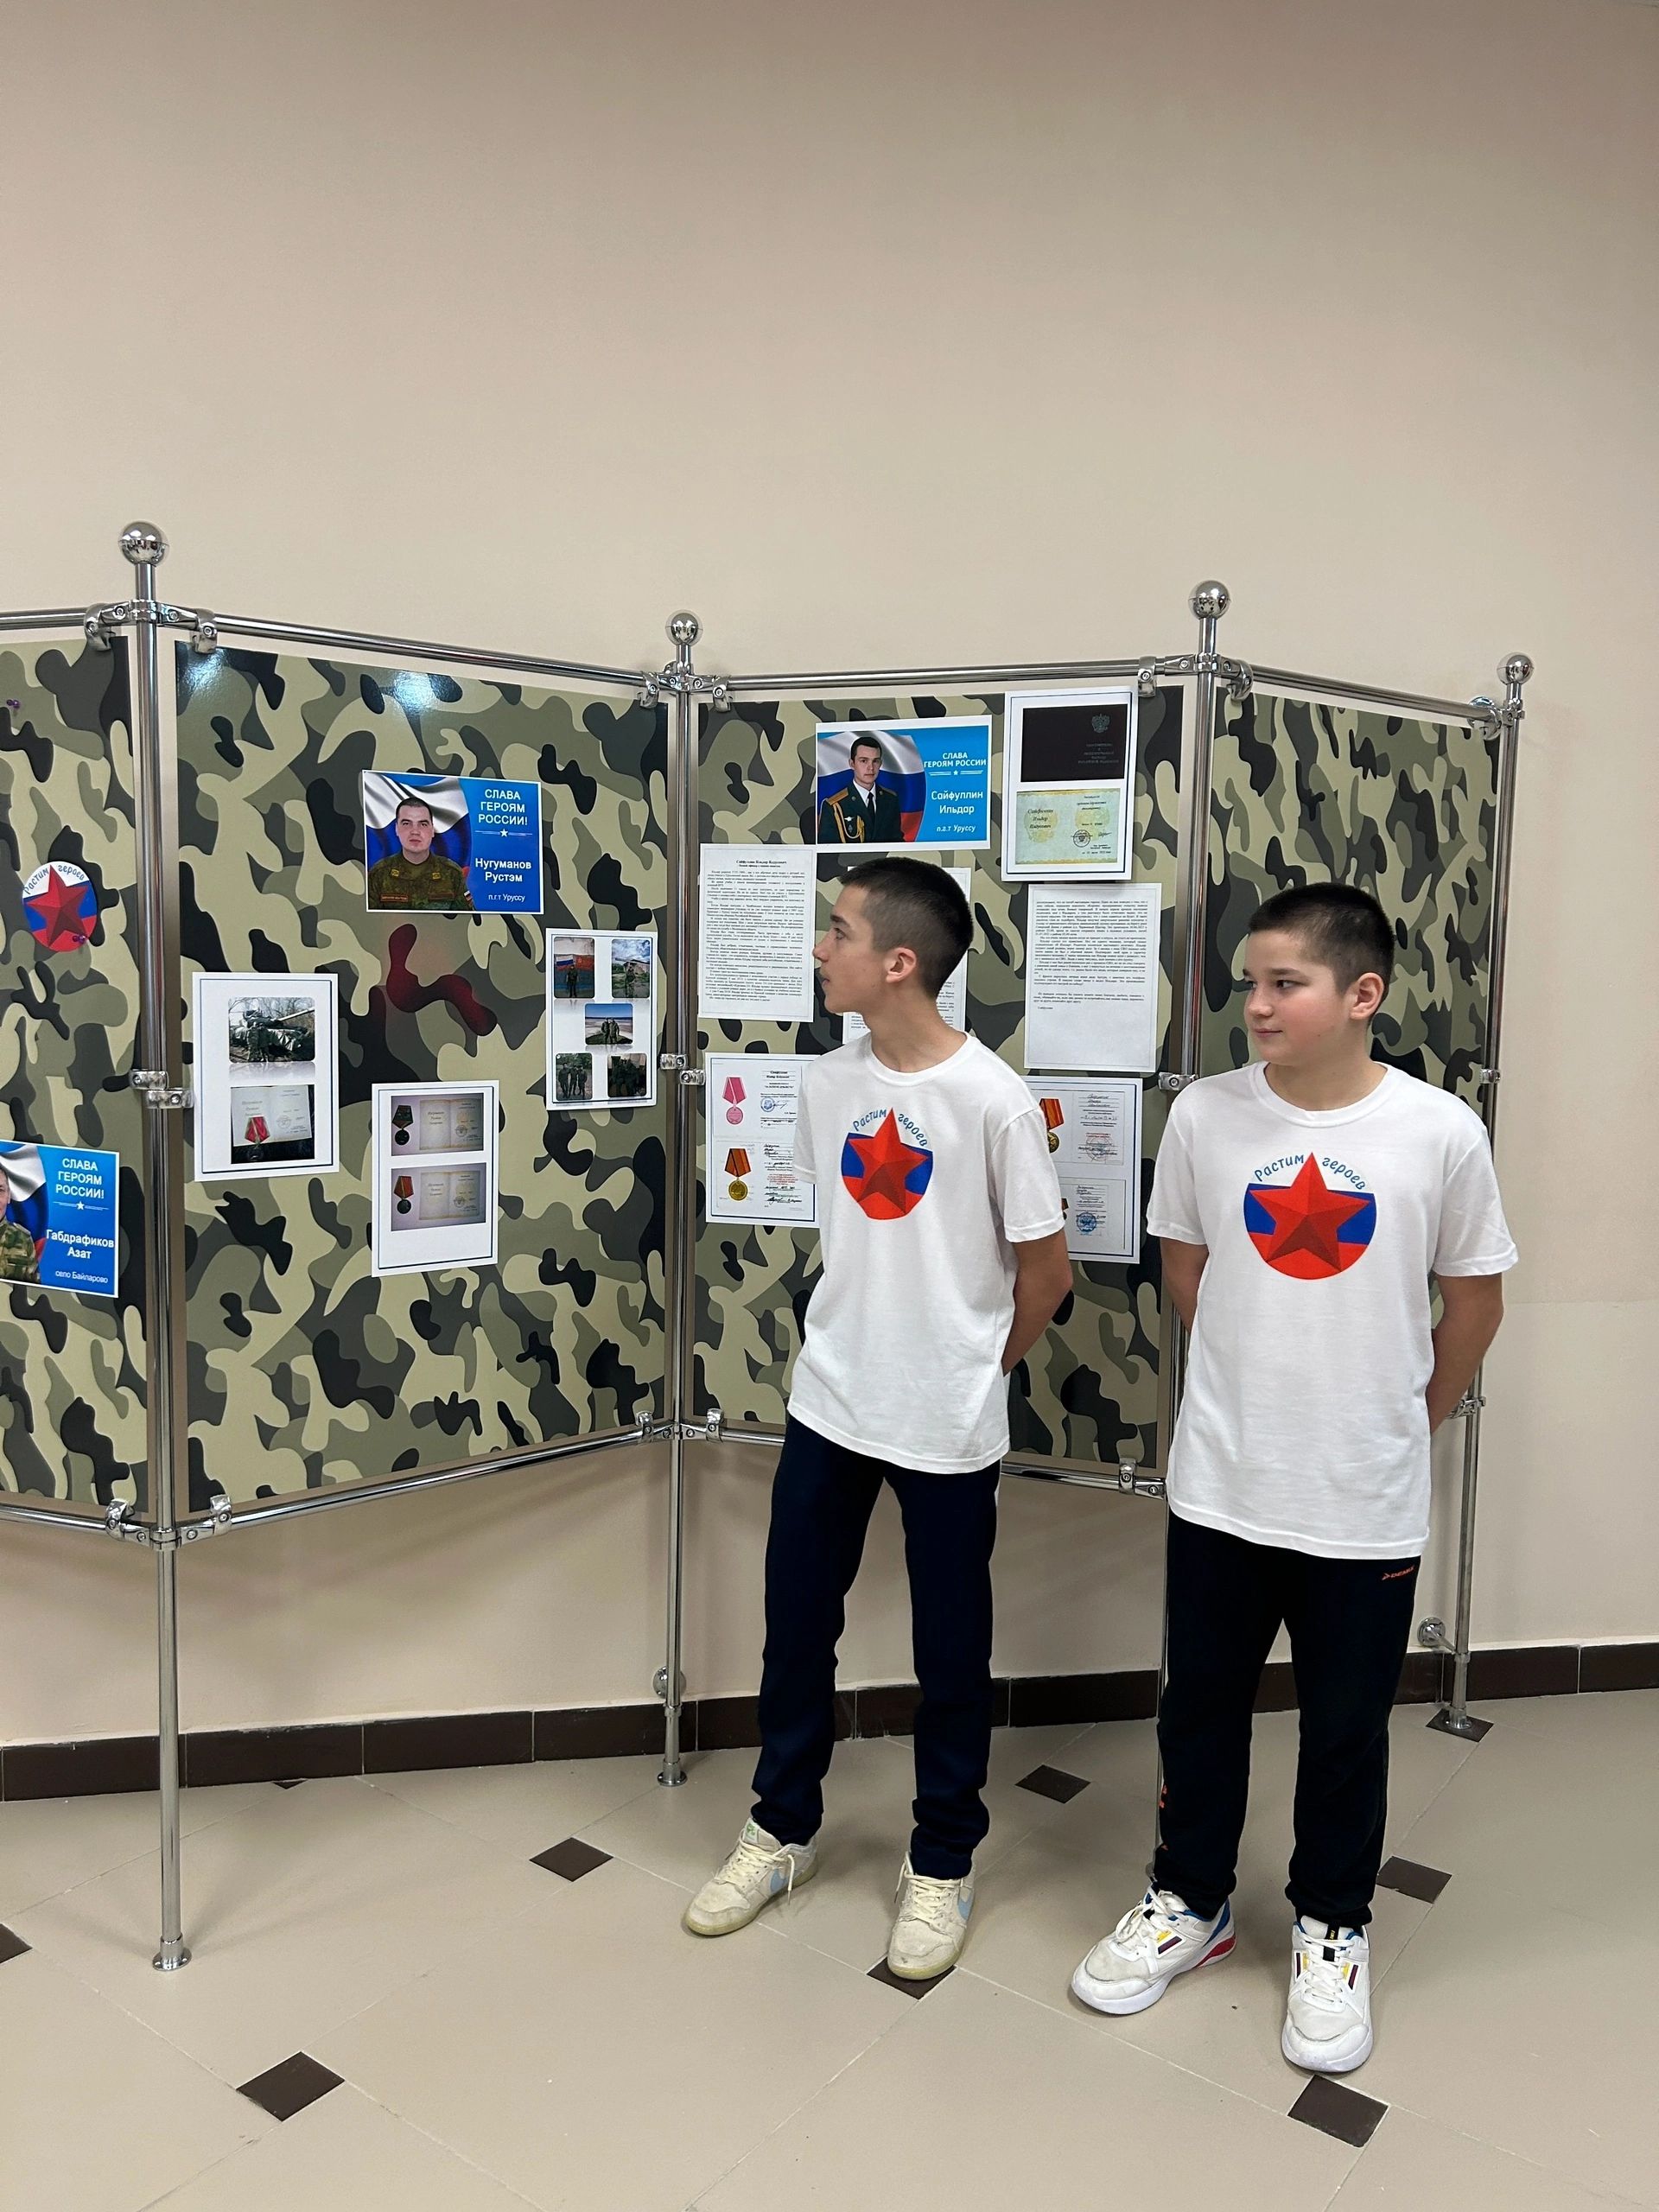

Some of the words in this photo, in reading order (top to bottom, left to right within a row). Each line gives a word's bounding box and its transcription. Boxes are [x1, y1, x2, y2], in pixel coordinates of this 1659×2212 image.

[485, 789, 521, 800] СЛАВА
[931, 790, 983, 801] Сайфуллин
[480, 802, 525, 813] ГЕРОЯМ
[939, 804, 975, 815] Ильдар
[478, 814, 528, 825] РОССИИ!
[953, 824, 976, 833] Уруссу
[475, 858, 531, 870] Нугуманов
[23, 868, 49, 895] Растим
[58, 865, 85, 880] героев
[485, 872, 523, 884] Рустэм
[502, 893, 525, 903] Уруссу
[852, 1109, 887, 1132] Растим
[898, 1113, 928, 1147] героев
[61, 1158, 98, 1171] СЛАВА
[58, 1171, 102, 1185] ГЕРОЯМ
[1254, 1154, 1305, 1182] Растим
[1322, 1157, 1365, 1190] героев
[55, 1184, 105, 1198] РОССИИ!
[46, 1229, 114, 1248] Габдрафиков
[67, 1246, 92, 1259] Азат
[55, 1270, 71, 1279] село
